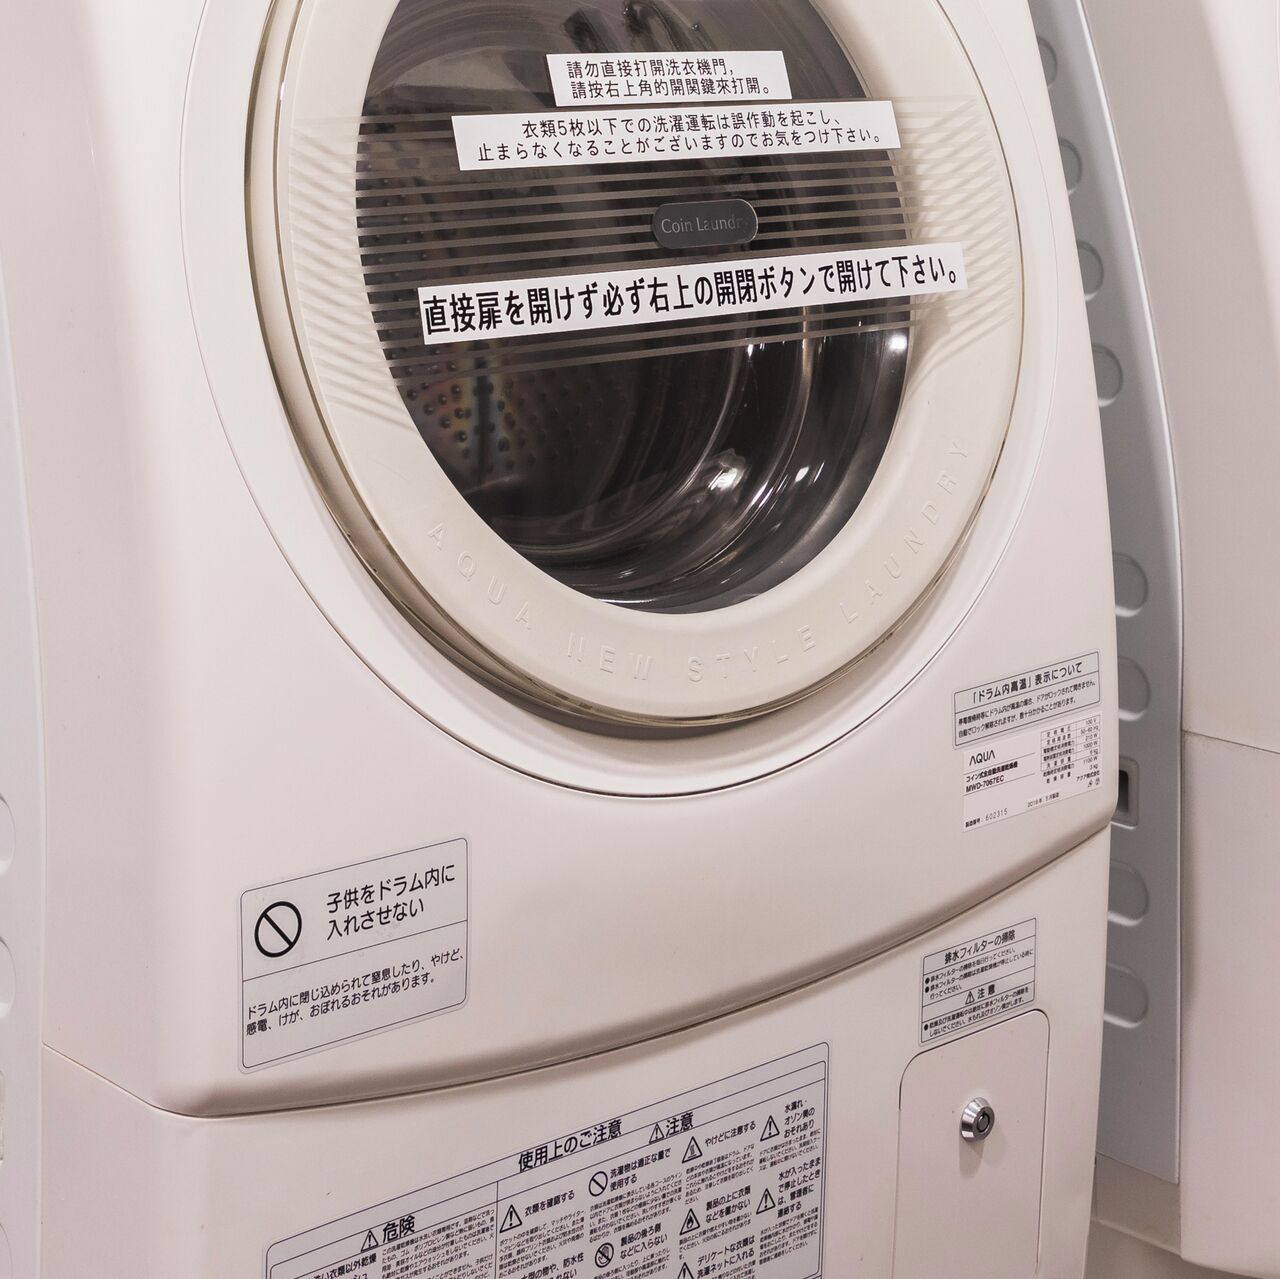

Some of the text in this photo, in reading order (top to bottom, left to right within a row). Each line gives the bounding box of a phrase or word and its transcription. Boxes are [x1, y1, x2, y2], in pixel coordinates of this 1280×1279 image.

[522, 108, 842, 138] 衣類5枚以下での洗濯運転は誤作動を起こし、
[477, 127, 882, 163] 止まらなくなることがございますのでお気をつけ下さい。
[661, 218, 693, 233] Coin
[423, 252, 959, 336] 直接扉を開けず必ず右上の開閉ボタンで開けて下さい。
[426, 440, 971, 684] AQUA NEW STYLE LAUNDRY
[969, 749, 995, 767] AQUA
[966, 775, 1005, 793] MWD-7067EC
[326, 864, 456, 914] 子供をドラム内に
[326, 898, 425, 941] 入れさせない
[944, 929, 1015, 965] 排水フィルターの掃除
[248, 948, 464, 1020] ドラム内に閉じ込められて窒息したり、やけど、
[246, 974, 434, 1036] 感電、けが、おぼれるおそれがあります。
[665, 1111, 694, 1137] 注意
[705, 1120, 756, 1146] やけどに注意する
[784, 1119, 815, 1139] おそれあり
[518, 1120, 622, 1171] 使用上のご注意
[610, 1174, 638, 1192] 使用する
[778, 1157, 821, 1181] 水が入ったまま
[524, 1190, 575, 1217] 衣類を確認する
[382, 1215, 416, 1244] 危険
[620, 1233, 668, 1259] などに入らない
